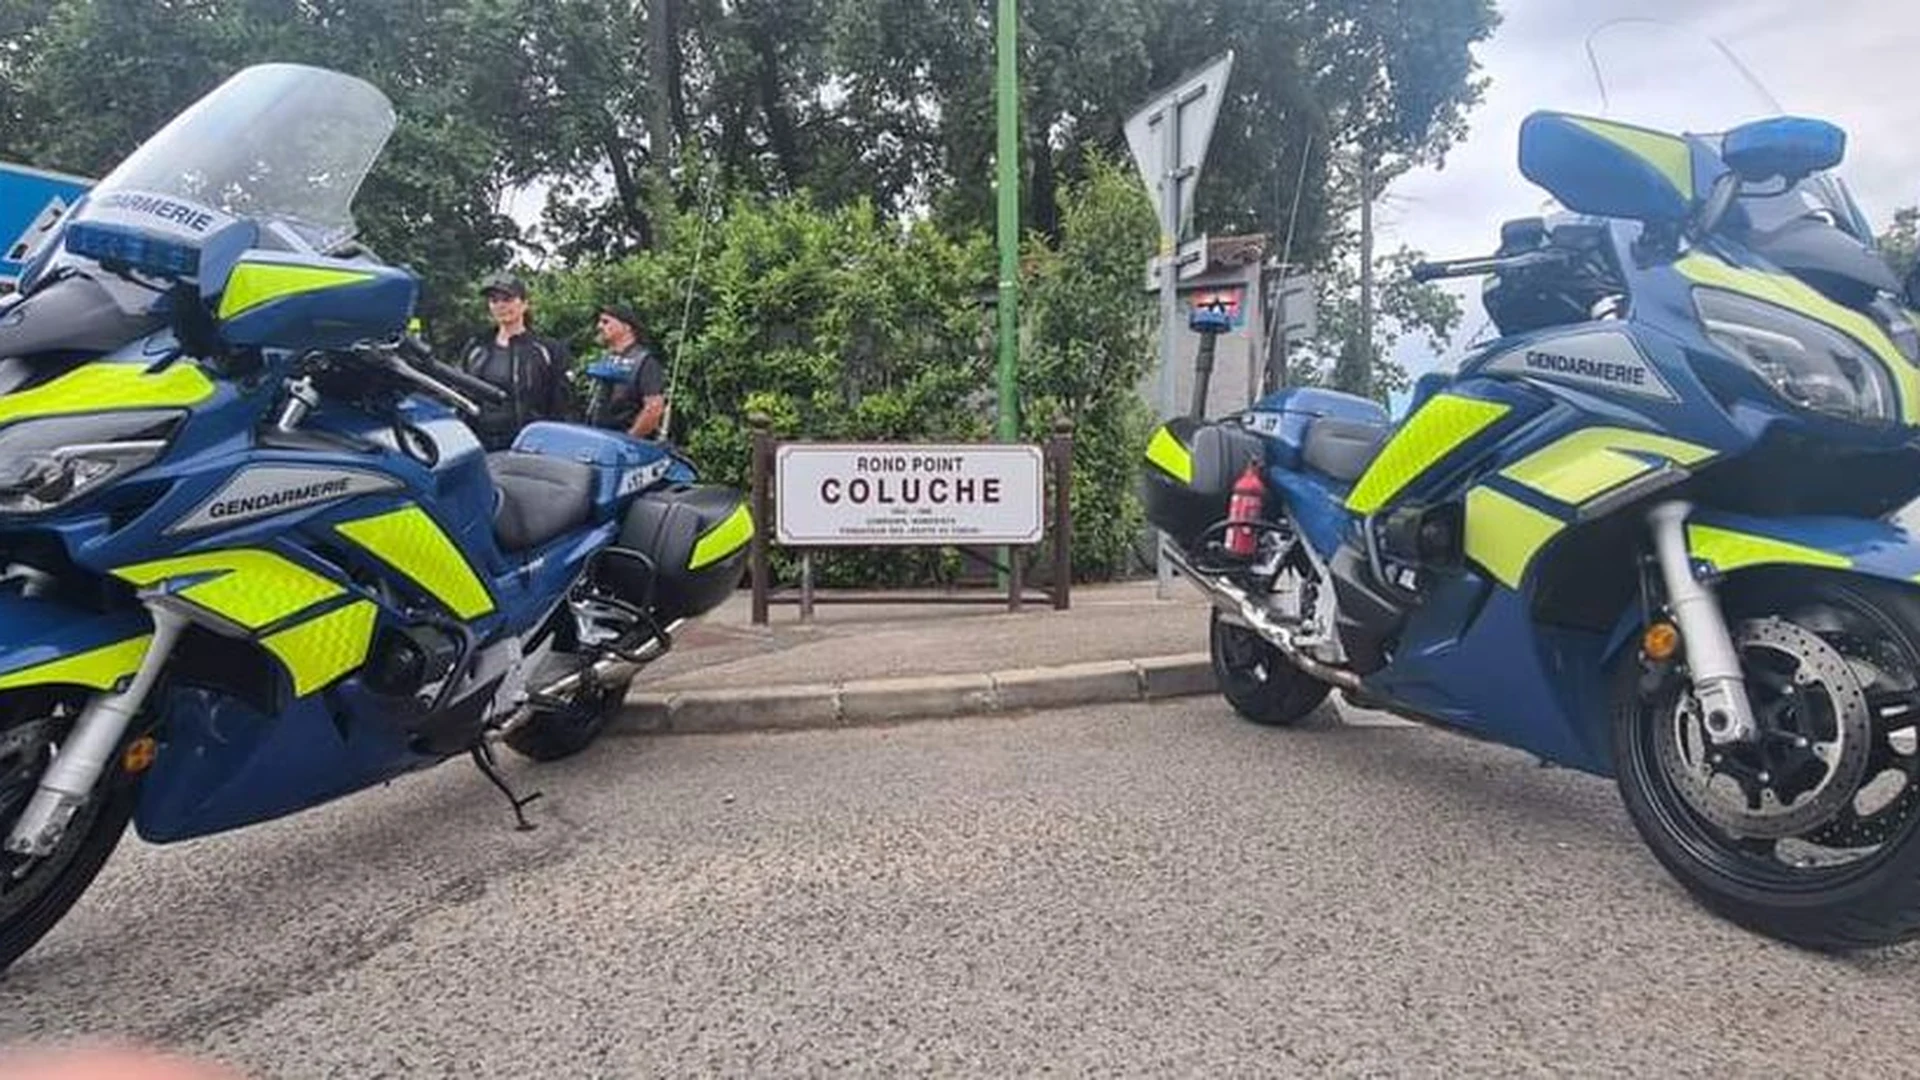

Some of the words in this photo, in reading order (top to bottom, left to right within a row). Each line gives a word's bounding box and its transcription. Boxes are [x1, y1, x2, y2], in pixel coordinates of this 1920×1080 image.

[1526, 350, 1646, 386] GENDARMERIE
[857, 456, 906, 472] ROND
[912, 456, 964, 472] POINT
[209, 476, 351, 518] GENDARMERIE
[820, 478, 1001, 504] COLUCHE
